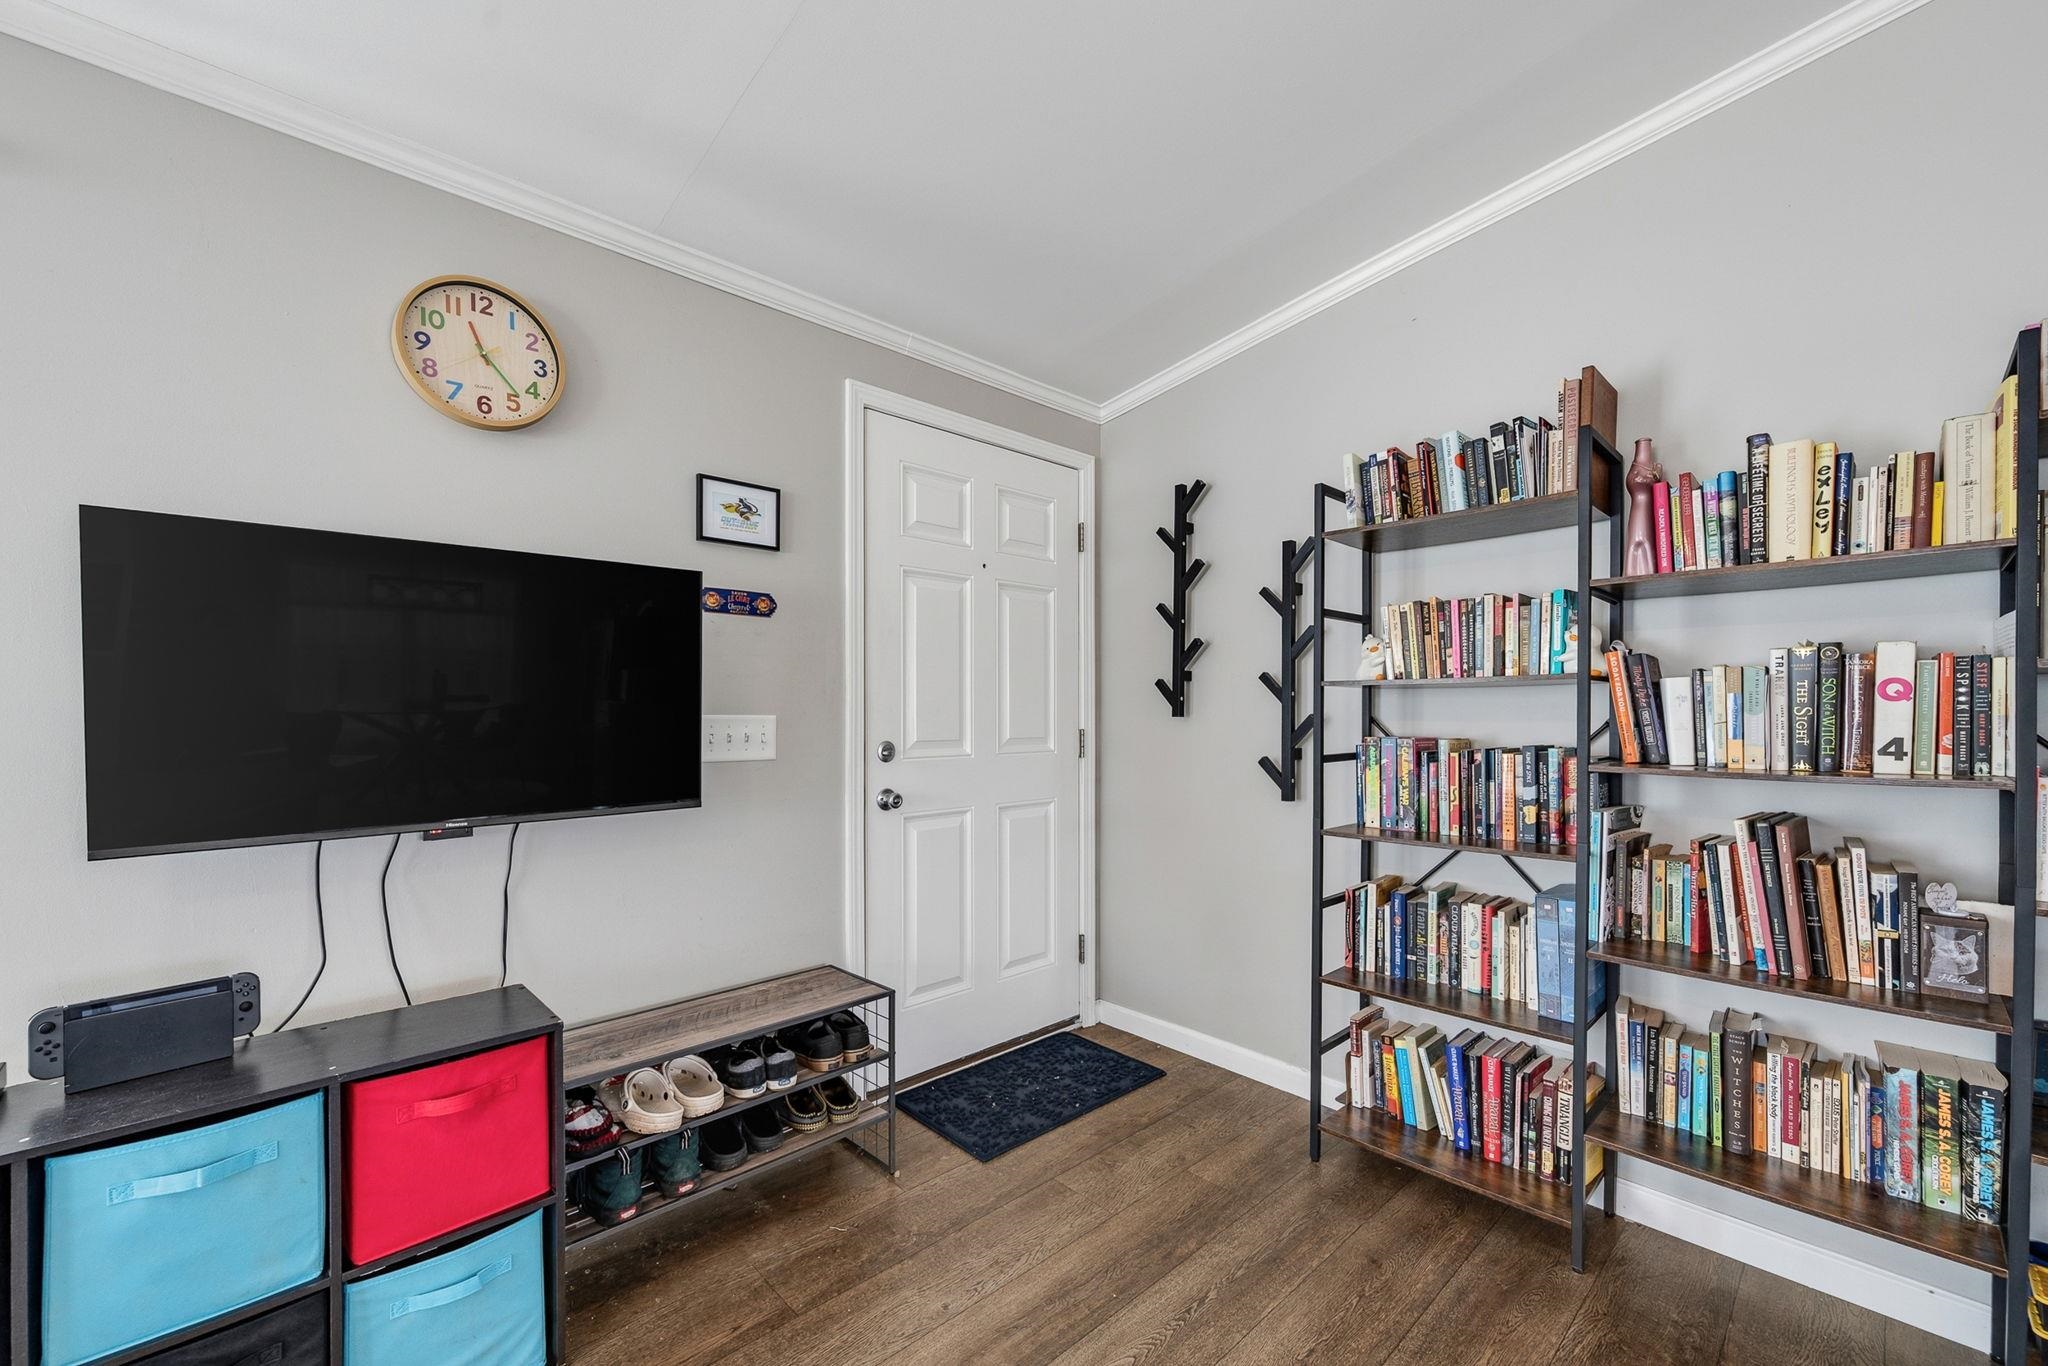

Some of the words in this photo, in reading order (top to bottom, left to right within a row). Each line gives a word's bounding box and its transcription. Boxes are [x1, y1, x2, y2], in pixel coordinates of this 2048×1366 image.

[445, 294, 461, 316] 11
[471, 293, 493, 316] 12
[420, 306, 445, 329] 10
[509, 311, 515, 330] 1
[414, 331, 431, 350] 9
[525, 332, 539, 352] 2
[421, 358, 438, 377] 8
[534, 359, 547, 378] 3
[446, 380, 463, 400] 7
[525, 382, 540, 399] 4
[477, 395, 492, 414] 6
[506, 393, 521, 412] 5
[1567, 387, 1577, 440] POSTSECRET
[1965, 424, 1974, 435] The
[1965, 436, 1974, 450] Book
[1752, 456, 1763, 492] LIFETIME
[1965, 459, 1973, 479] Virtues
[1752, 494, 1763, 505] OF
[1965, 486, 1974, 509] William
[1753, 507, 1764, 542] SECRETS
[1965, 515, 1973, 536] Bennett
[1632, 665, 1643, 687] Moby
[1922, 665, 1931, 687] FAMILY
[1976, 662, 1987, 688] STIFF
[1796, 680, 1808, 703] THE
[1822, 677, 1836, 703] SON
[1876, 676, 1914, 703] Q
[1922, 687, 1931, 714] PICTURES
[1821, 715, 1835, 755] WITCH
[1877, 737, 1908, 762] 4
[1401, 788, 1409, 805] WAR
[1855, 852, 1863, 869] GROW
[1842, 878, 1851, 898] Lighting
[1844, 899, 1854, 922] Handbook
[1769, 1054, 1779, 1073] killing
[1503, 1066, 1512, 1093] WHILE
[1771, 1074, 1779, 1085] the
[1730, 1055, 1744, 1129] WITCHES
[1771, 1085, 1779, 1103] black
[1899, 1080, 1913, 1116] JAMES
[1543, 1096, 1552, 1115] COMING
[1769, 1103, 1779, 1120] body
[1938, 1088, 1951, 1127] JAMES
[1503, 1104, 1512, 1133] SLEPT
[1543, 1116, 1552, 1126] OUT
[1559, 1097, 1570, 1146] TRIANGLE
[1900, 1119, 1911, 1129] S.
[1980, 1099, 1995, 1141] JAMES
[1543, 1126, 1552, 1142] UNDER
[1938, 1128, 1951, 1139] S.
[1938, 1141, 1951, 1153] A.
[1980, 1141, 1994, 1151] S.
[1900, 1148, 1913, 1184] COREY
[1980, 1153, 1994, 1165] A.
[1938, 1155, 1952, 1196] COREY
[1979, 1168, 1994, 1209] COREY
